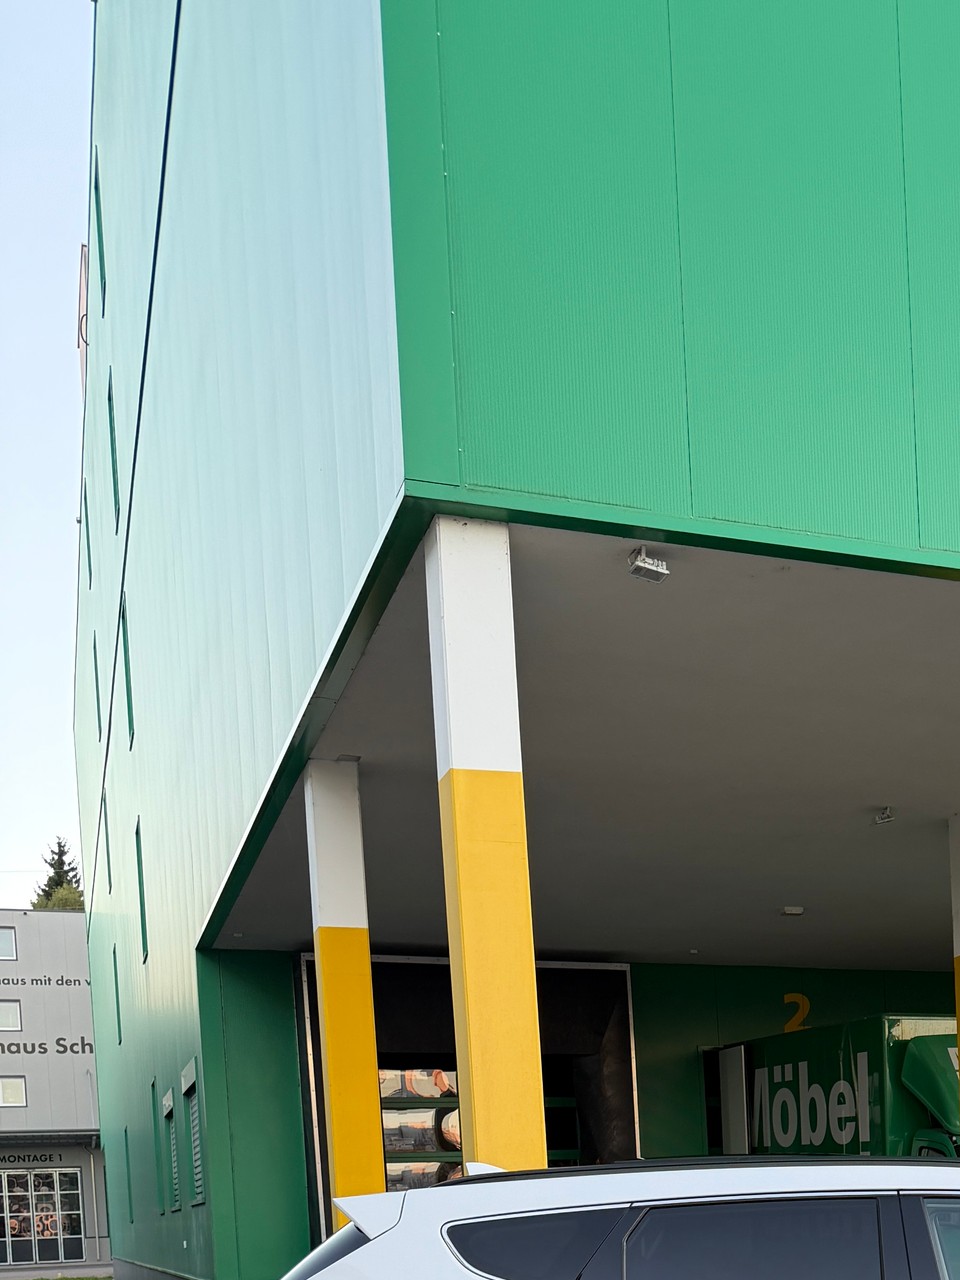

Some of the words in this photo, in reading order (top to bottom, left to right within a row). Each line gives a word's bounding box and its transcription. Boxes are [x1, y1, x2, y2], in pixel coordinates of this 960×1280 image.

[0, 977, 26, 986] aus
[31, 975, 52, 986] mit
[56, 975, 81, 986] den
[783, 993, 811, 1033] 2
[55, 1036, 94, 1055] Sch
[0, 1153, 54, 1163] MONTAGE
[59, 1153, 63, 1162] 1
